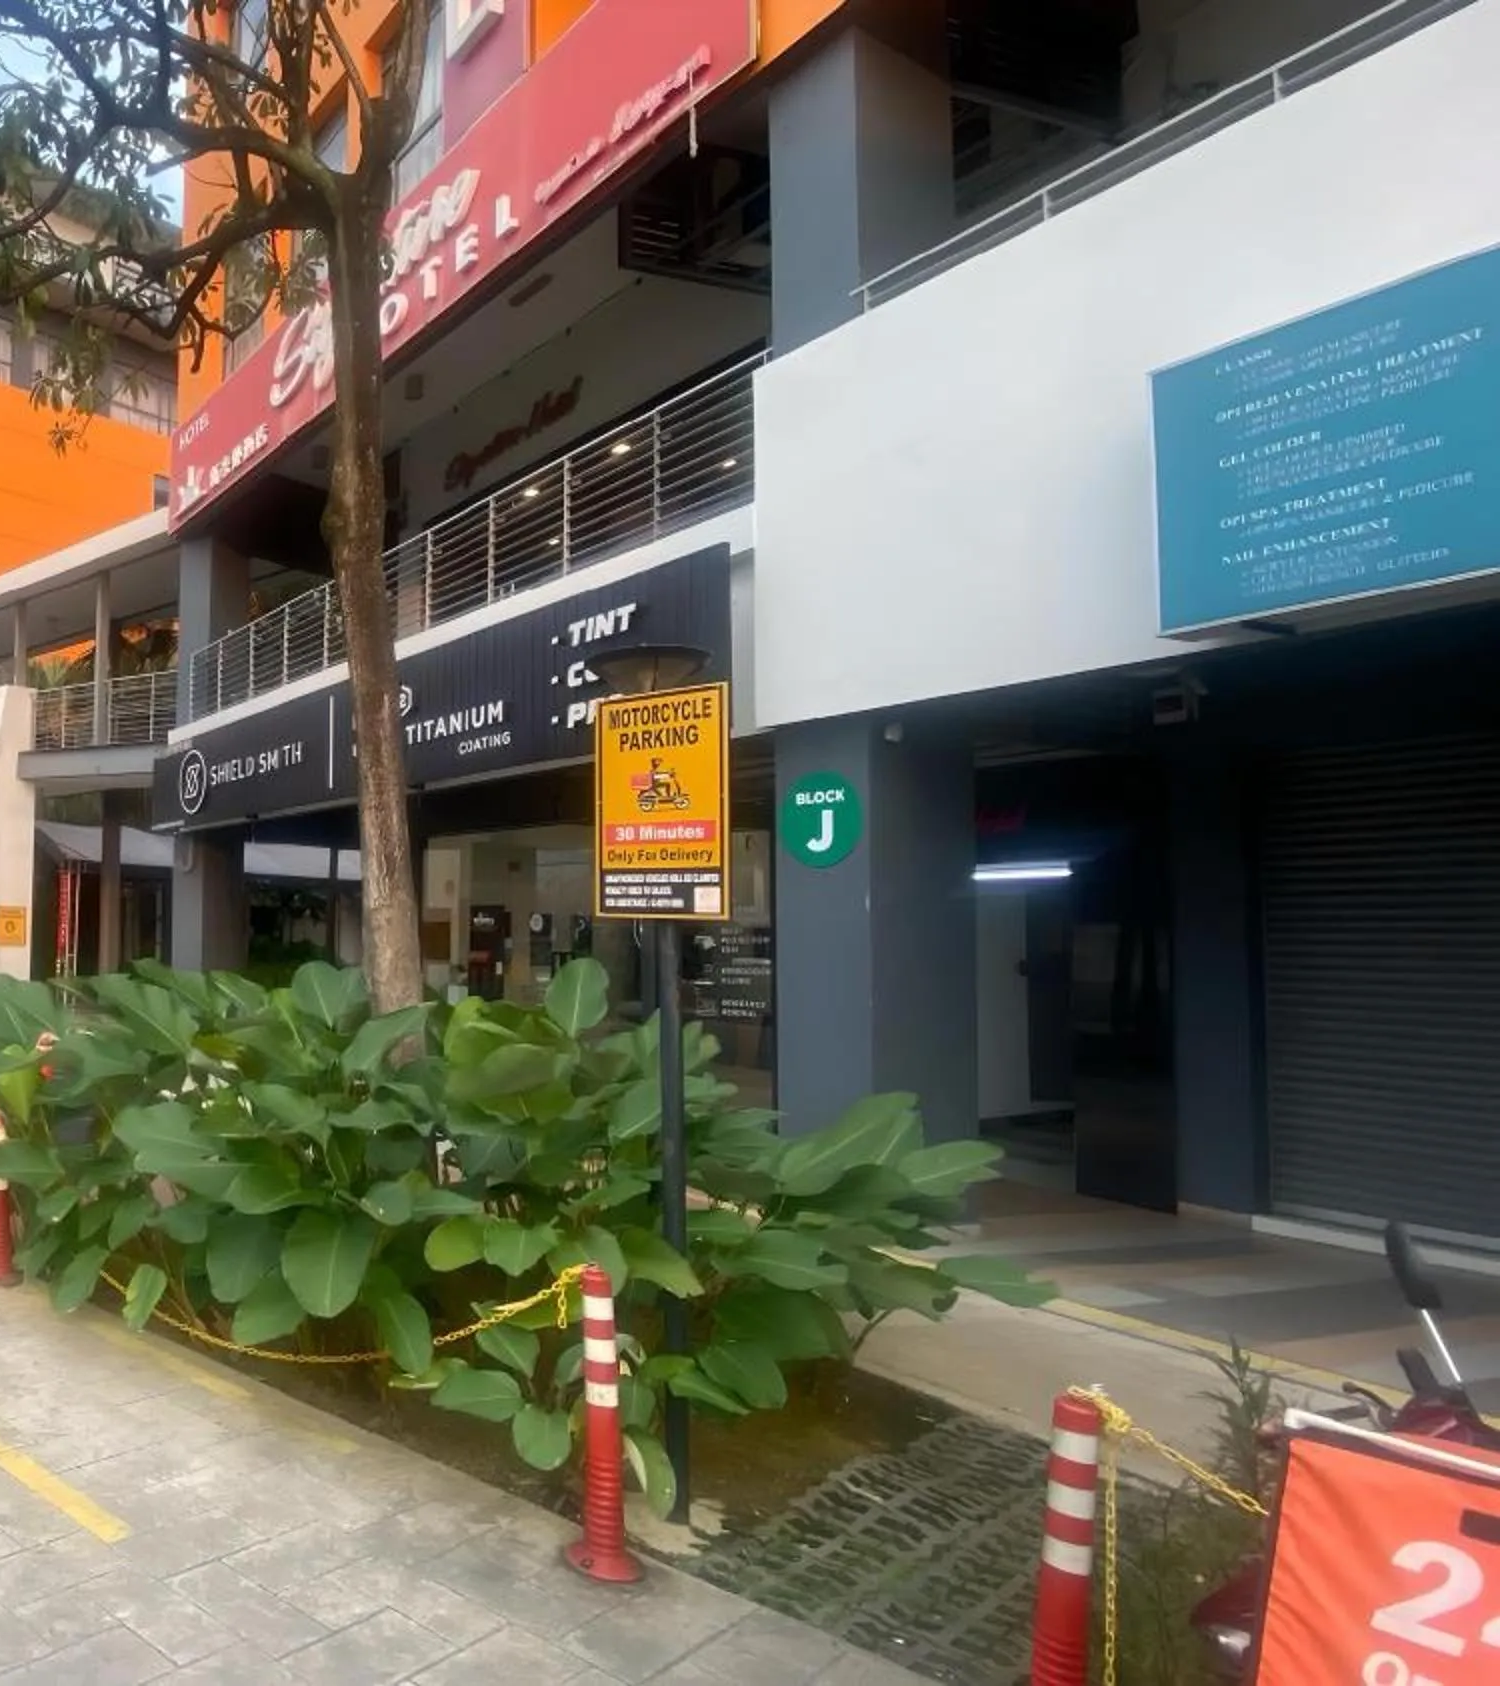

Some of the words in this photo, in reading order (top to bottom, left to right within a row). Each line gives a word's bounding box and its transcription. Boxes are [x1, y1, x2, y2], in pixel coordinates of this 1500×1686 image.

[567, 602, 638, 648] TINT
[405, 700, 504, 744] TITANIUM
[609, 697, 712, 730] MOTORCYCLE
[457, 731, 512, 755] COATING
[619, 725, 700, 752] PARKING
[210, 756, 256, 787] SHIELD
[795, 787, 845, 806] BLOCK
[615, 827, 635, 841] 30
[639, 824, 706, 841] Minutes
[805, 809, 834, 853] J
[607, 850, 634, 864] Only
[659, 847, 713, 863] Delivery
